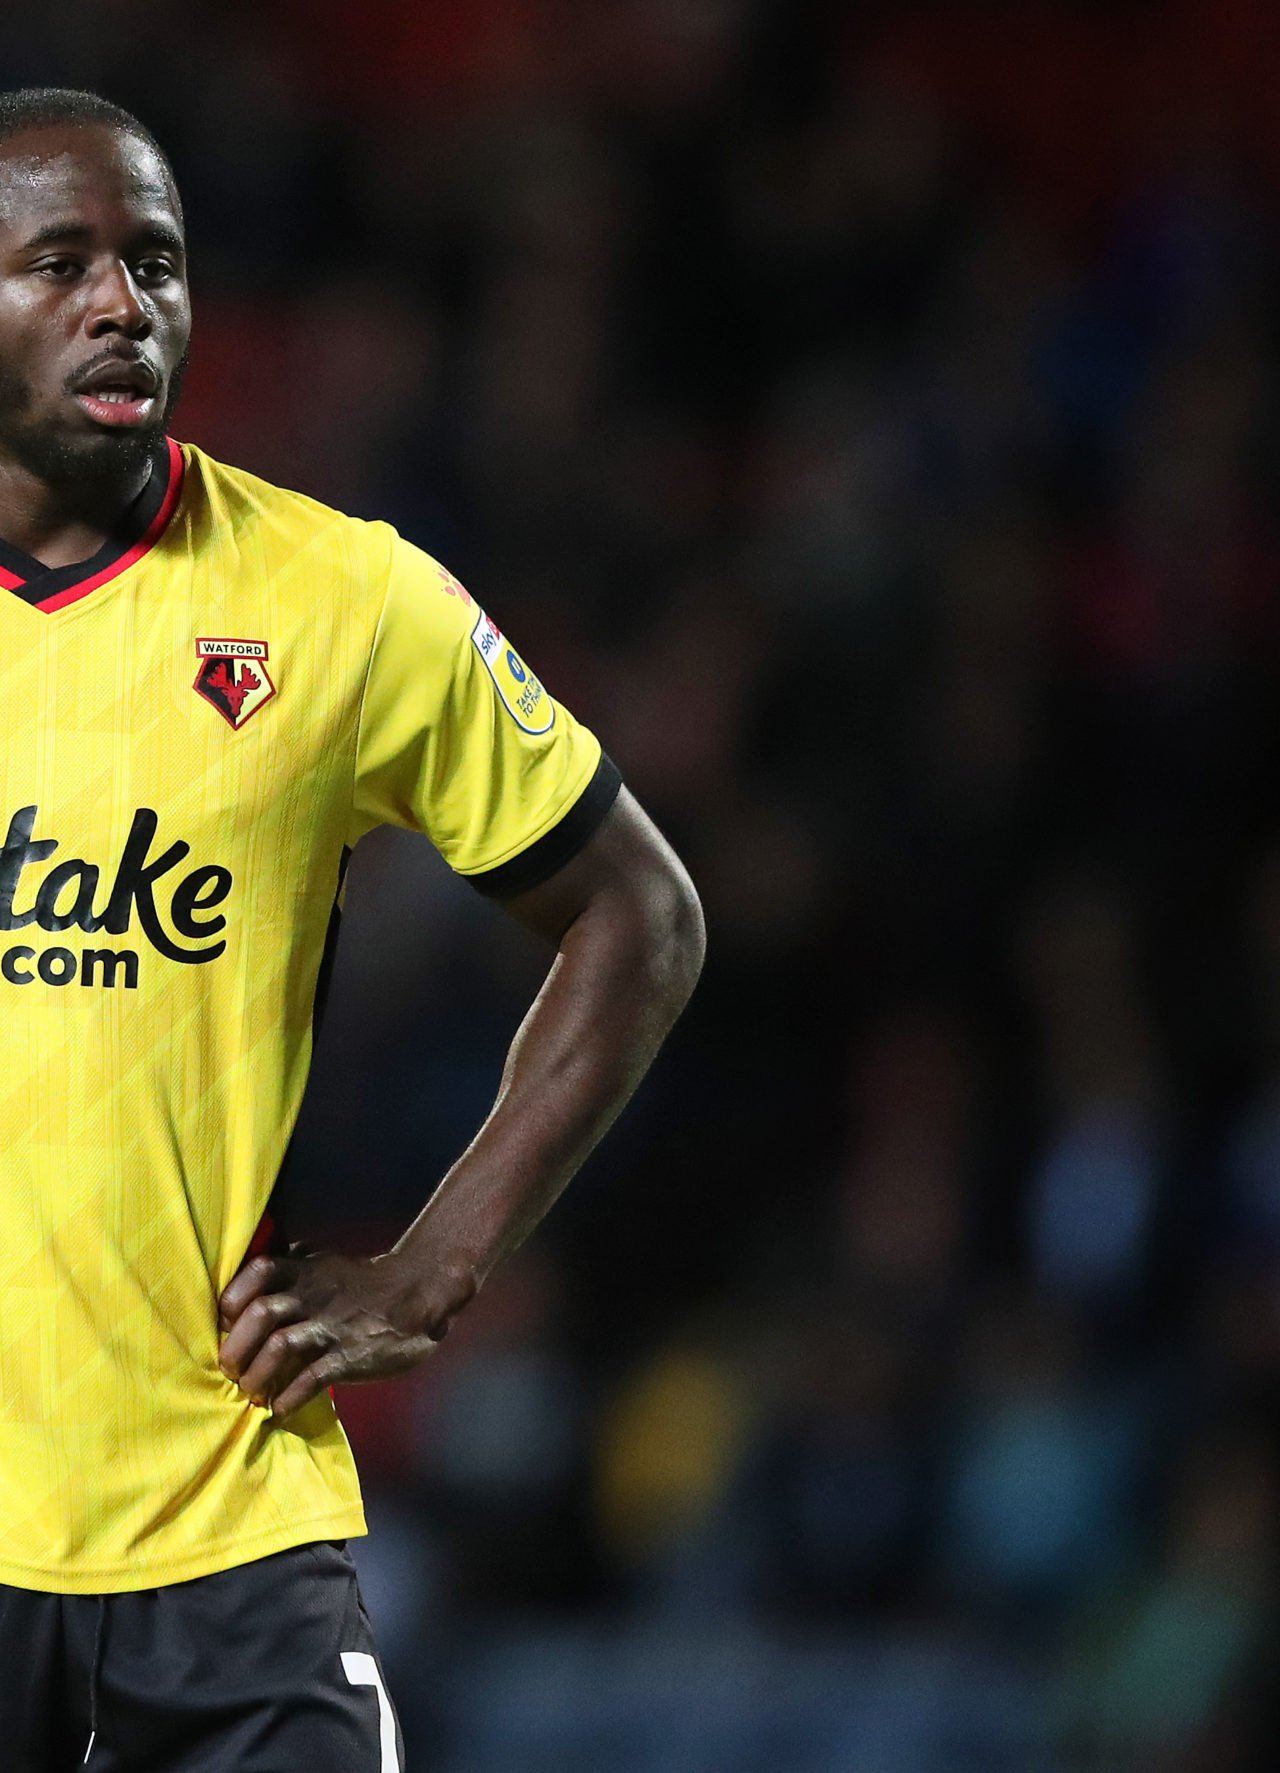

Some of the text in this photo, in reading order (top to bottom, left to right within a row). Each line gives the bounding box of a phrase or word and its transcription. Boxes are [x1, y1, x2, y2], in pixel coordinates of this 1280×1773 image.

[203, 643, 262, 655] WATFORD
[481, 629, 496, 655] sky
[339, 1651, 400, 1773] 7
